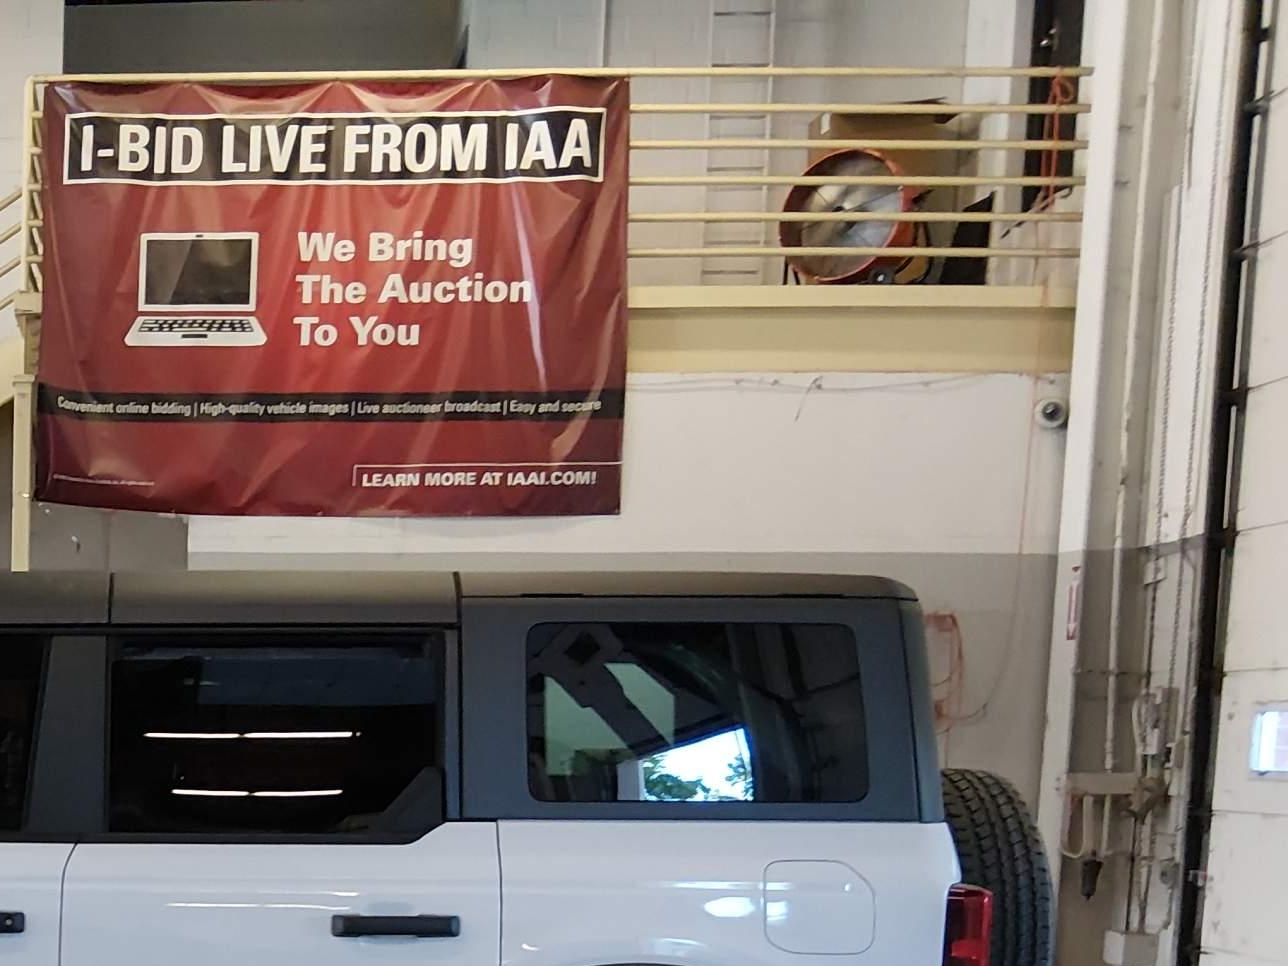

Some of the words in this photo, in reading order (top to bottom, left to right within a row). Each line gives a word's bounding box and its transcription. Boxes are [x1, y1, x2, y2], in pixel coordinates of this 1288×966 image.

[80, 124, 204, 174] I-BID
[221, 124, 331, 173] LIVE
[343, 123, 489, 173] FROM
[505, 118, 592, 171] IAA
[297, 231, 356, 262] We
[368, 230, 473, 268] Bring
[295, 274, 367, 304] The
[377, 272, 533, 304] Auction
[292, 316, 338, 347] To
[349, 316, 421, 346] You
[57, 395, 114, 414] Convenient
[115, 401, 150, 414] online
[151, 401, 191, 417] bidding
[199, 401, 265, 417] High-quality
[267, 401, 307, 415] vehicle
[308, 400, 350, 416] images
[357, 401, 380, 414] Live
[381, 401, 442, 414] auctioneer
[443, 400, 501, 414] broadcast
[509, 400, 536, 416] Easy
[537, 400, 560, 413] and
[561, 400, 602, 413] secure
[362, 473, 421, 487] LEARN
[424, 472, 477, 486] MORE
[479, 472, 503, 486] AT
[507, 471, 597, 486] IAAI.COM!
